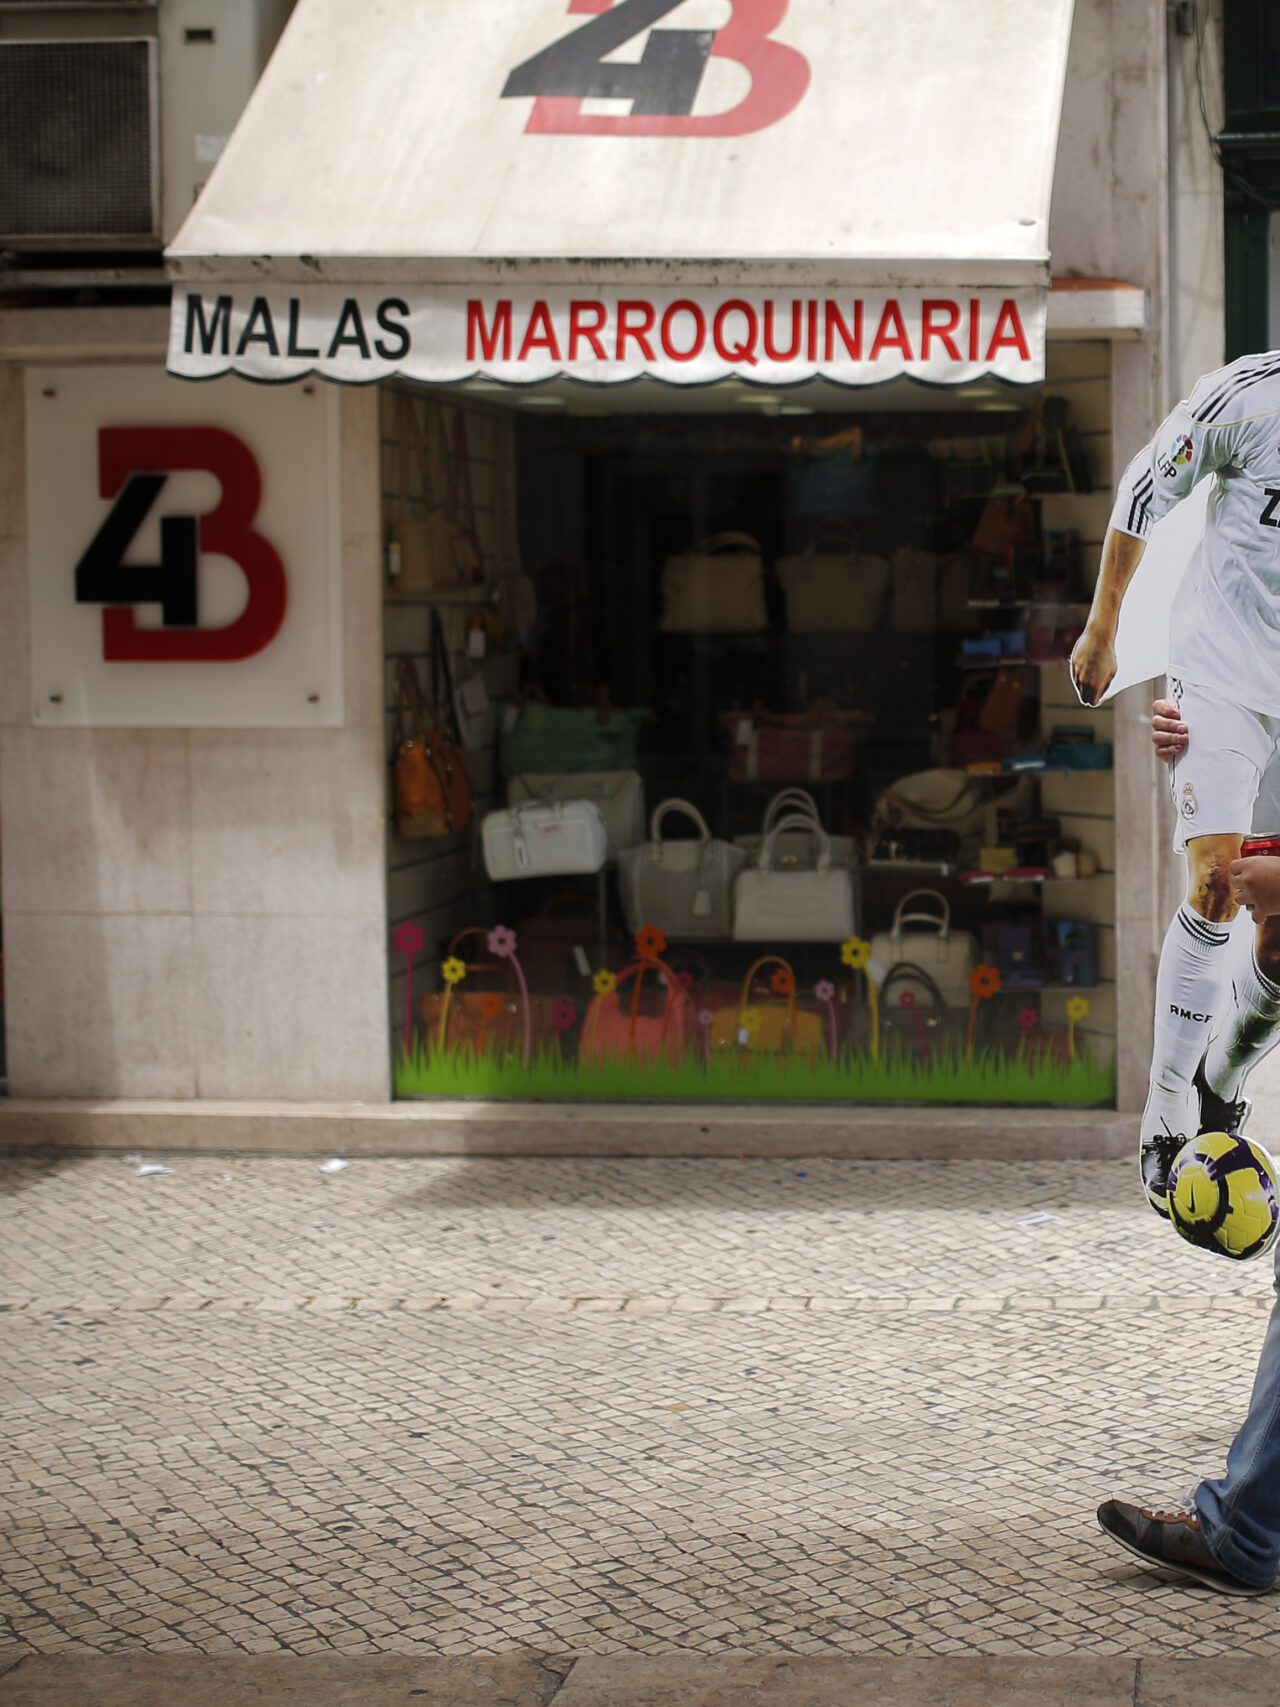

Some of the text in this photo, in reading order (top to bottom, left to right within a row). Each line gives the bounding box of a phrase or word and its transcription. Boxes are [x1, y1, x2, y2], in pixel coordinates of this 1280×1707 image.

[182, 292, 1031, 366] MALAS MARROQUINARIA
[1157, 452, 1178, 479] LFP
